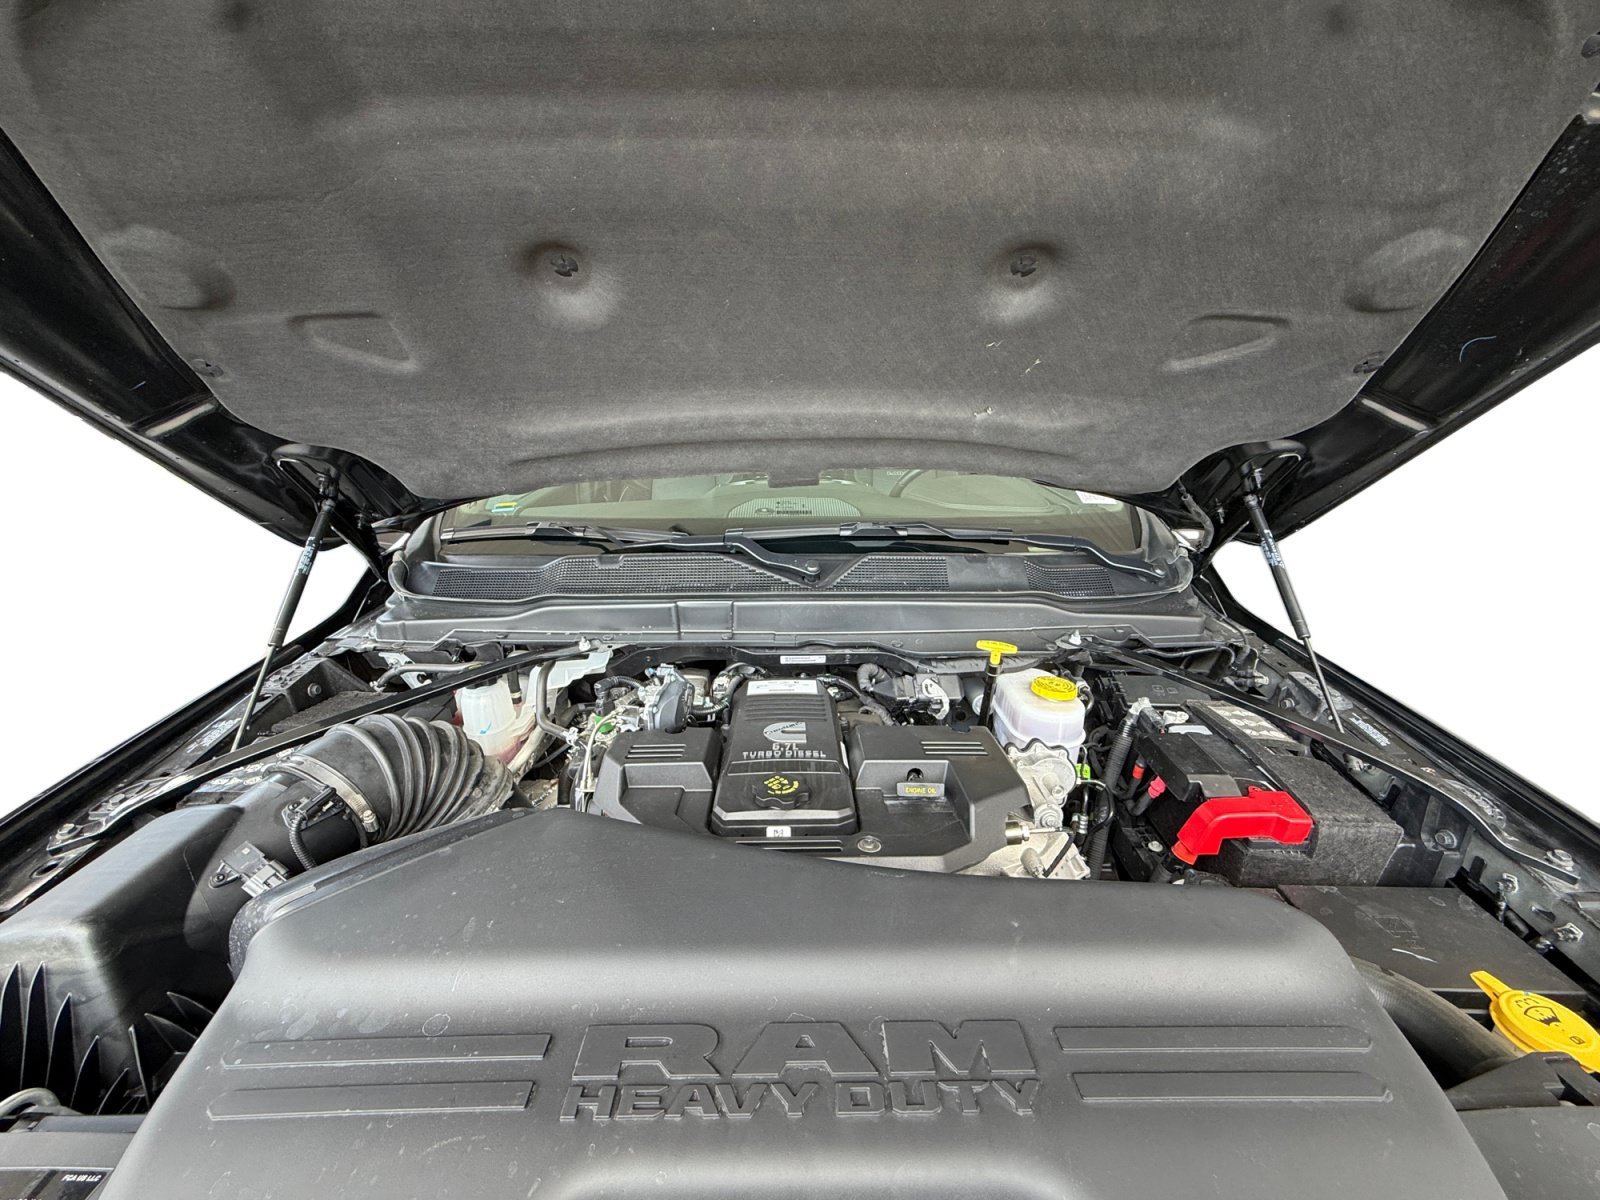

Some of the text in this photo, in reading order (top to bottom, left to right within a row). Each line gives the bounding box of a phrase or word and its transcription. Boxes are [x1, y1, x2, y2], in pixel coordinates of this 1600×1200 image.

[742, 750, 827, 760] TURBO DIESEL
[772, 742, 799, 751] 6.7L
[571, 1019, 1038, 1080] RAM
[559, 1078, 1041, 1122] HEAVY DUTY
